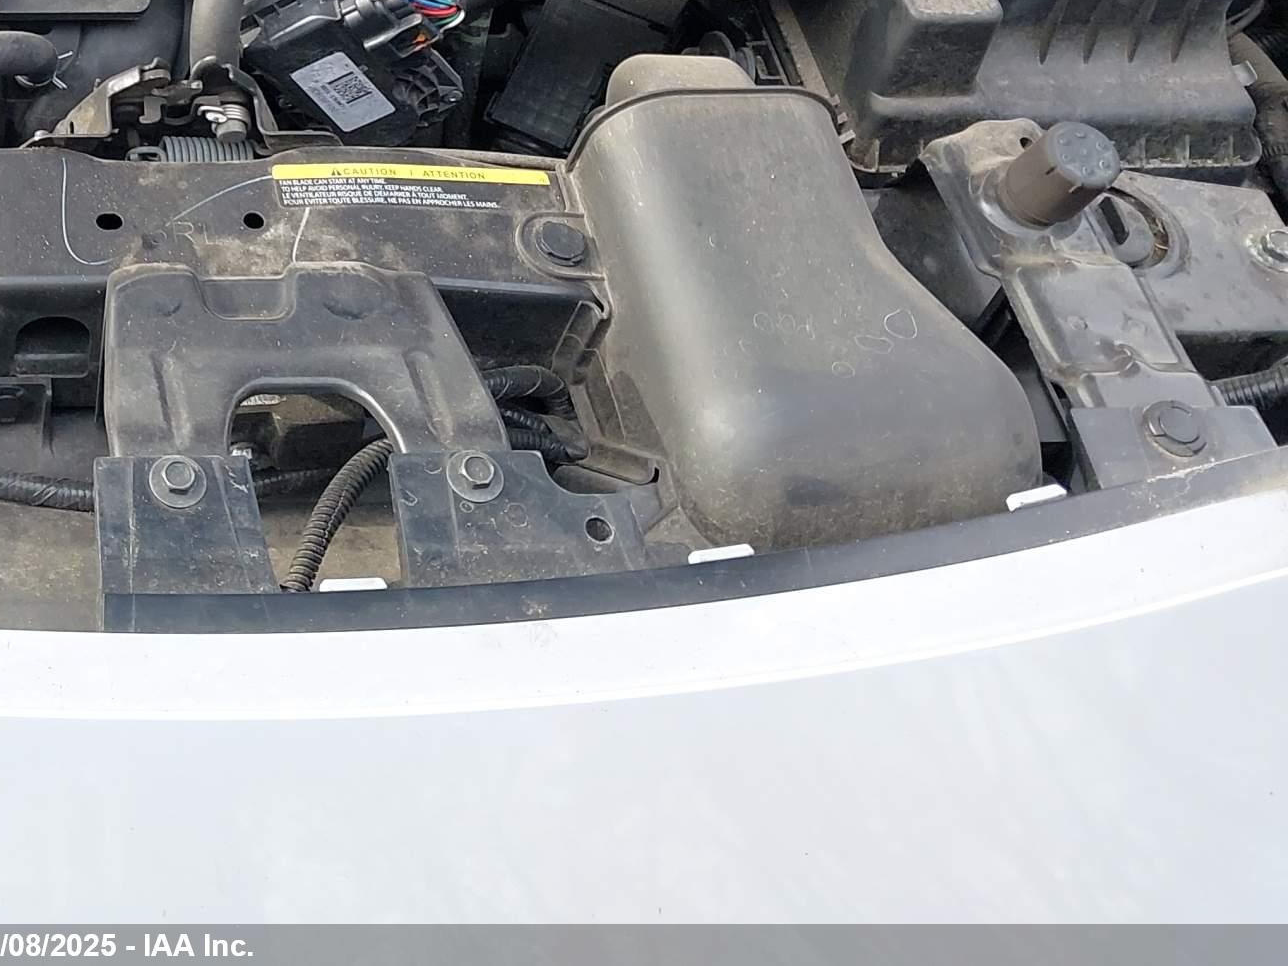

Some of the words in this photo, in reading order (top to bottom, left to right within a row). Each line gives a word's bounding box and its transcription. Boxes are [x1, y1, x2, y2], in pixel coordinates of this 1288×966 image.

[343, 168, 397, 176] CAUTION
[423, 170, 486, 180] ATTENTION
[290, 191, 337, 199] VENTILATEUR
[422, 199, 463, 207] APPROCHER
